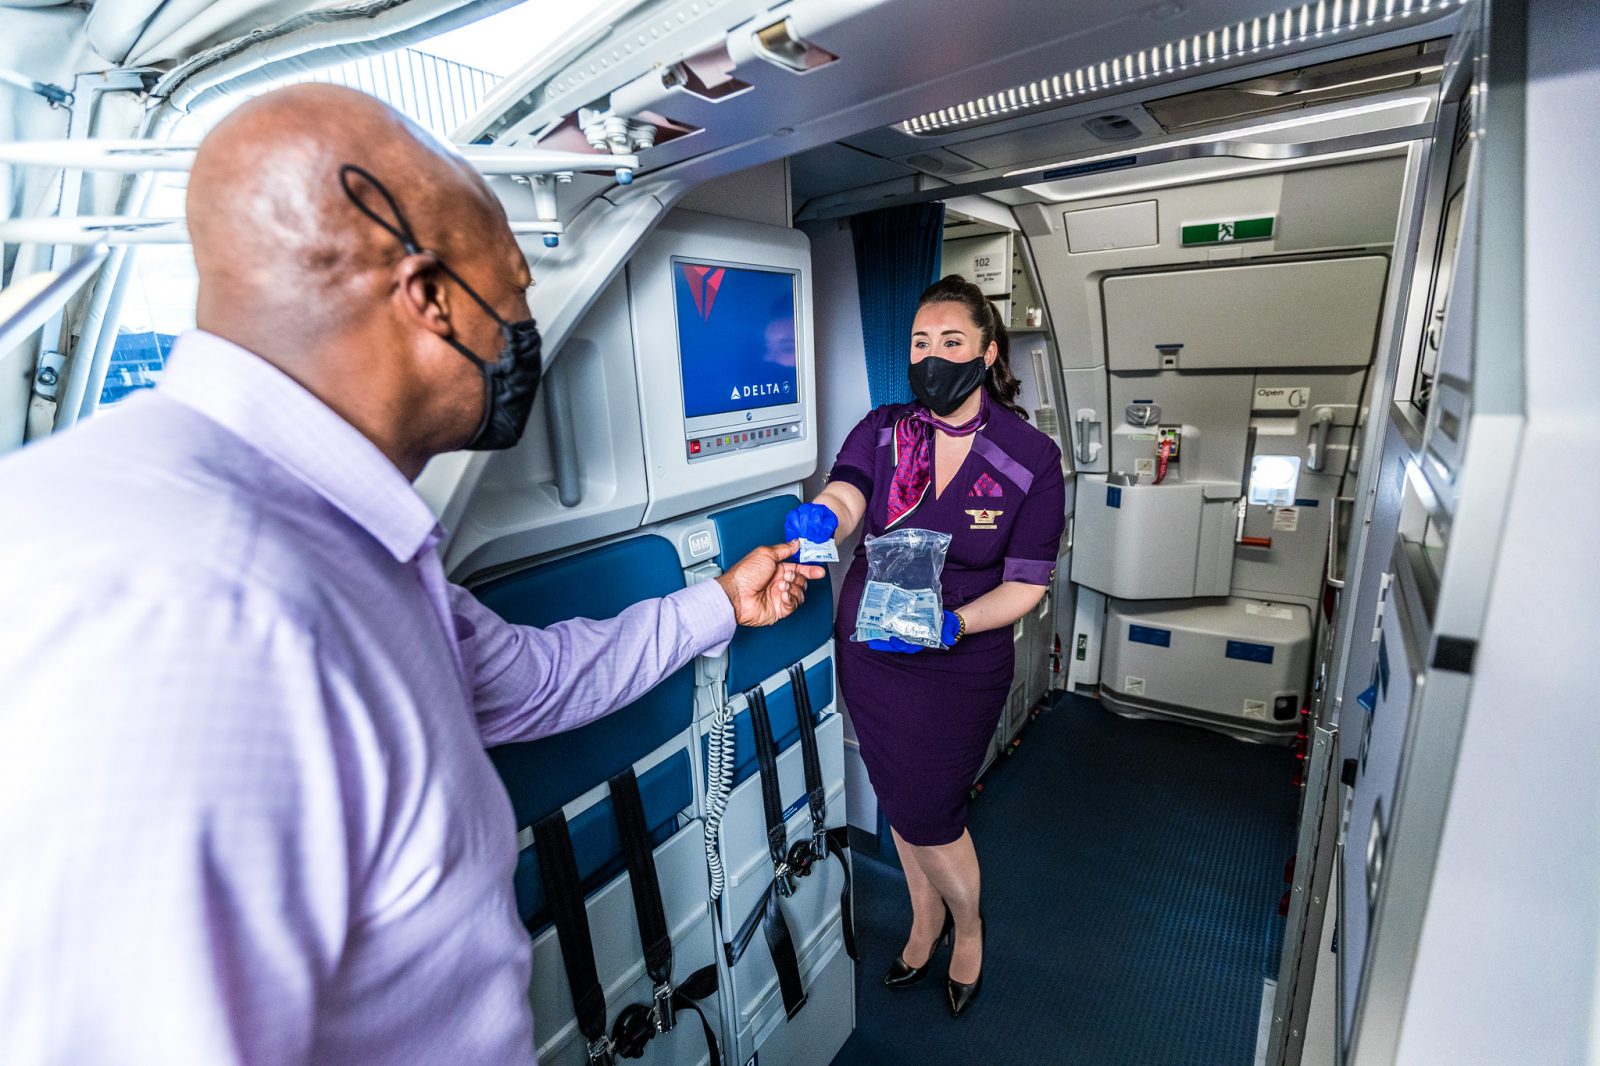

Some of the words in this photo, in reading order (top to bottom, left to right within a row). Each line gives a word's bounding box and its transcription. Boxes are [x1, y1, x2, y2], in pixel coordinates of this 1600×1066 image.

[975, 257, 990, 267] 102
[743, 383, 780, 397] DELTA
[1258, 389, 1284, 397] Open
